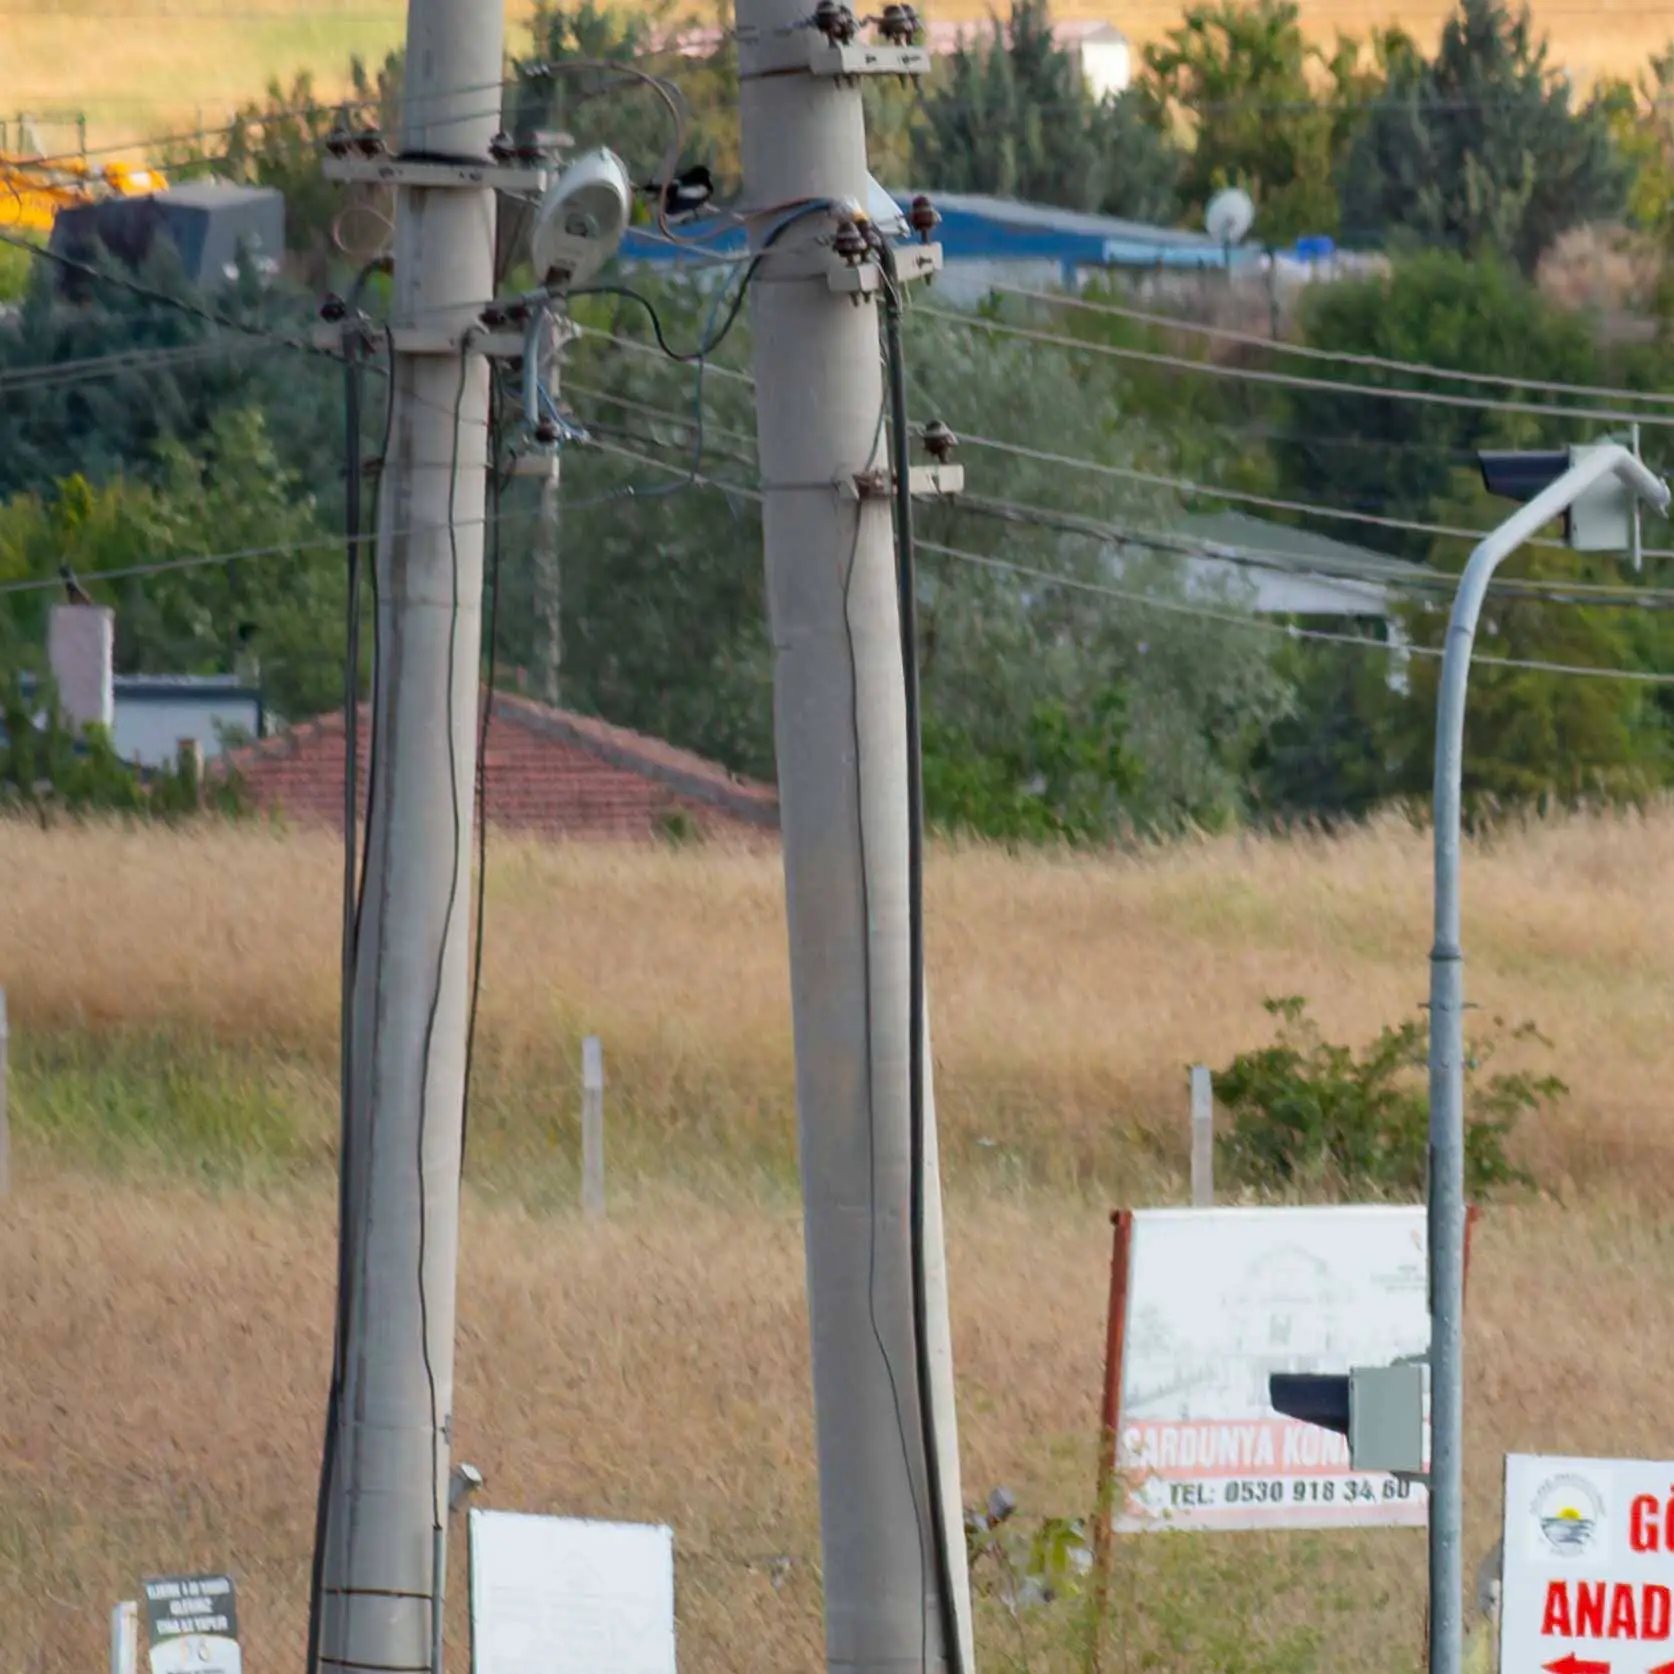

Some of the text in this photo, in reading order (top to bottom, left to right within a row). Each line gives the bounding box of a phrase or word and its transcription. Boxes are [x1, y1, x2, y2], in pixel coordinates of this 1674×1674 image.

[1168, 1483, 1215, 1506] TEL:
[1224, 1480, 1283, 1504] 0530
[1291, 1479, 1335, 1502] 918
